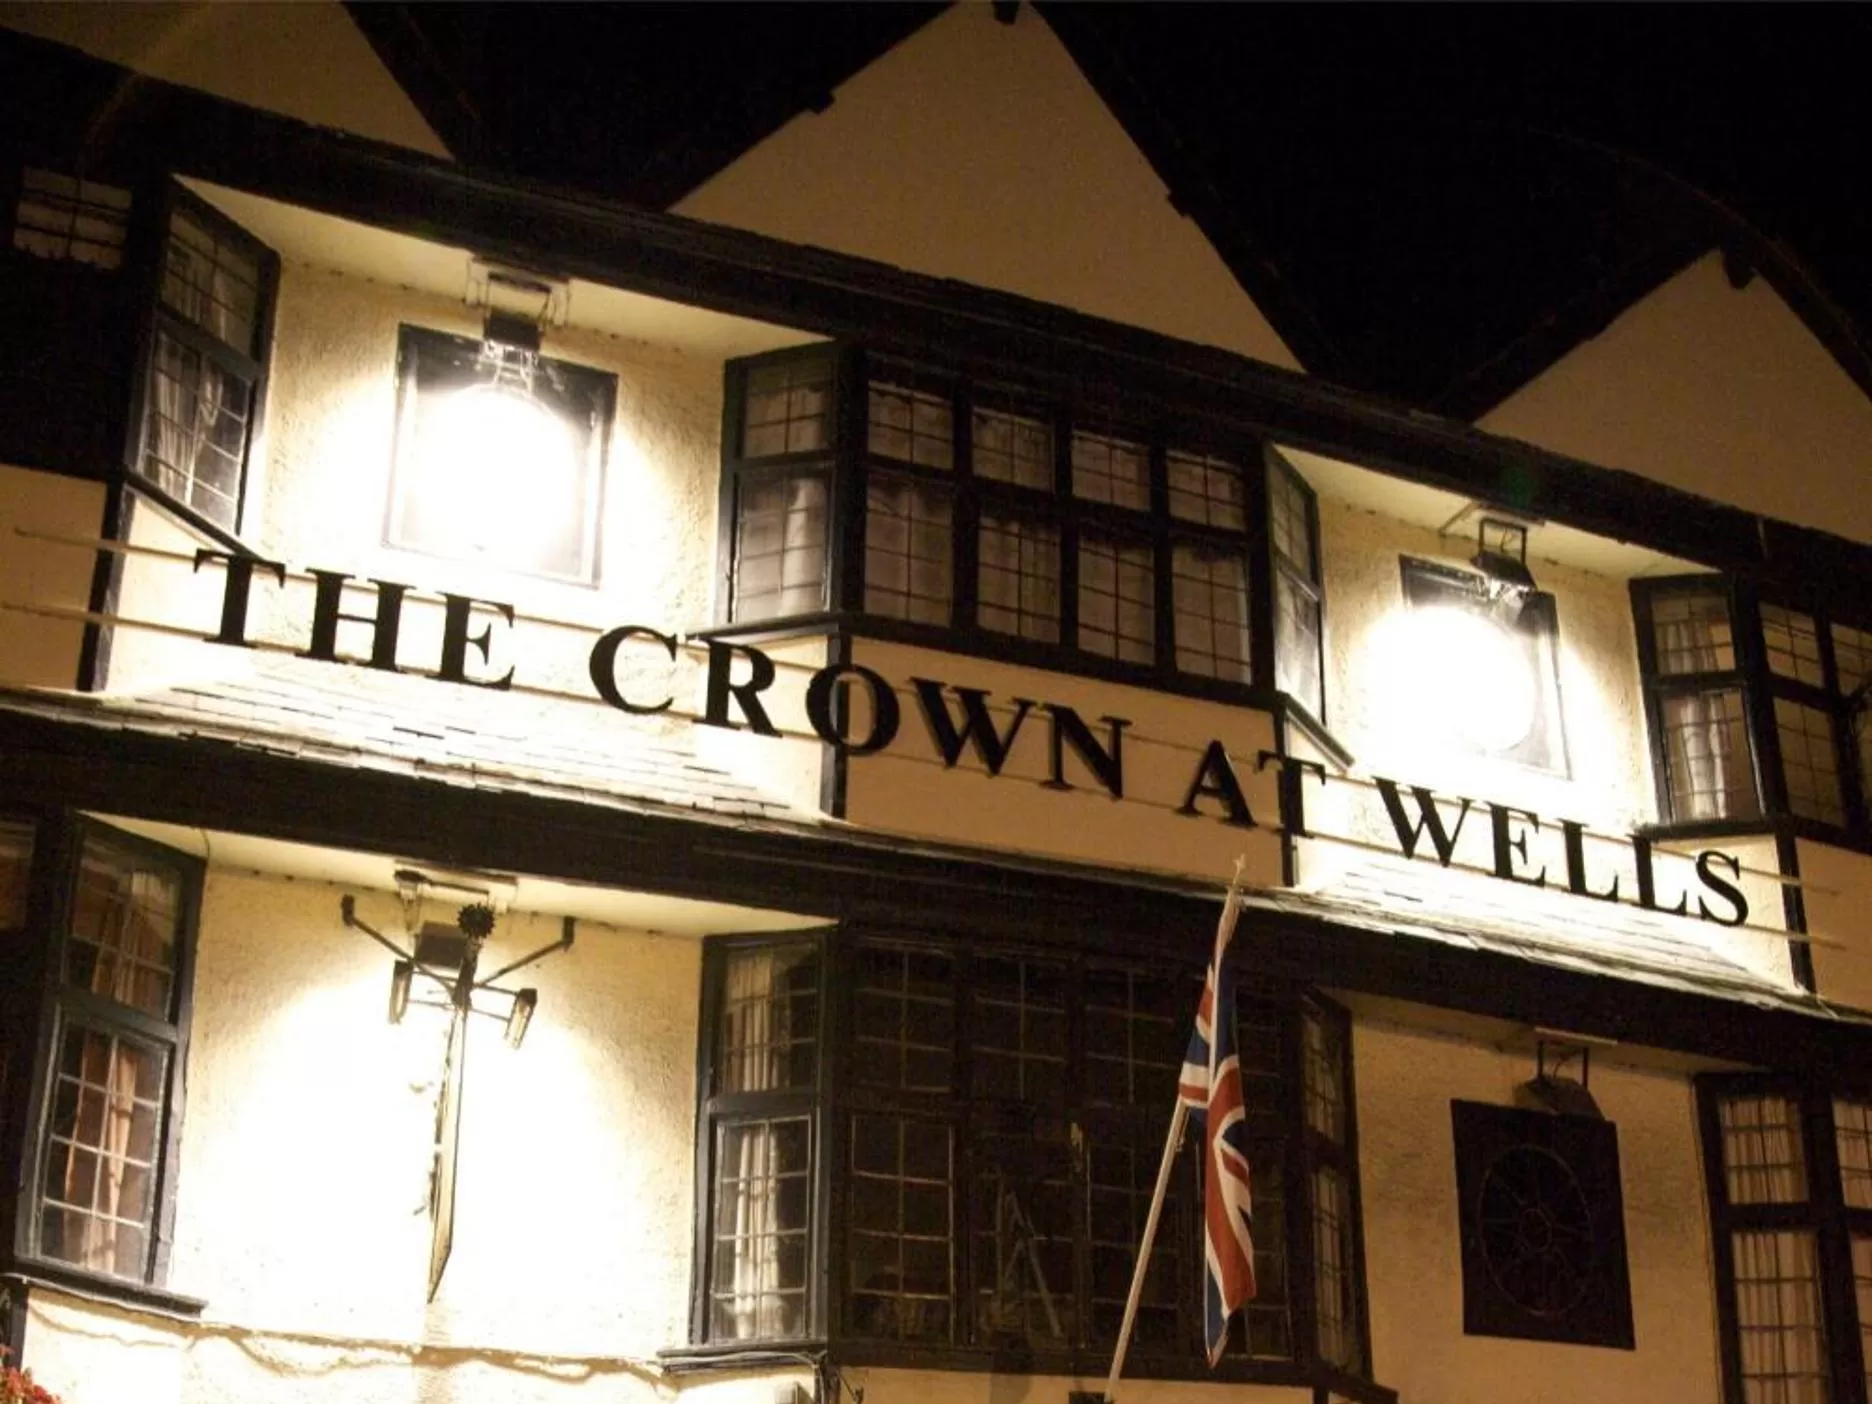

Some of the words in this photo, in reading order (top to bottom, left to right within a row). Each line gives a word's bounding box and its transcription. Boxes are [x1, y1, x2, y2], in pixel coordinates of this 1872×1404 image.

[193, 547, 517, 692] THE
[589, 624, 1133, 799] CROWN
[1174, 739, 1328, 838] AT
[1370, 775, 1751, 927] WELLS
